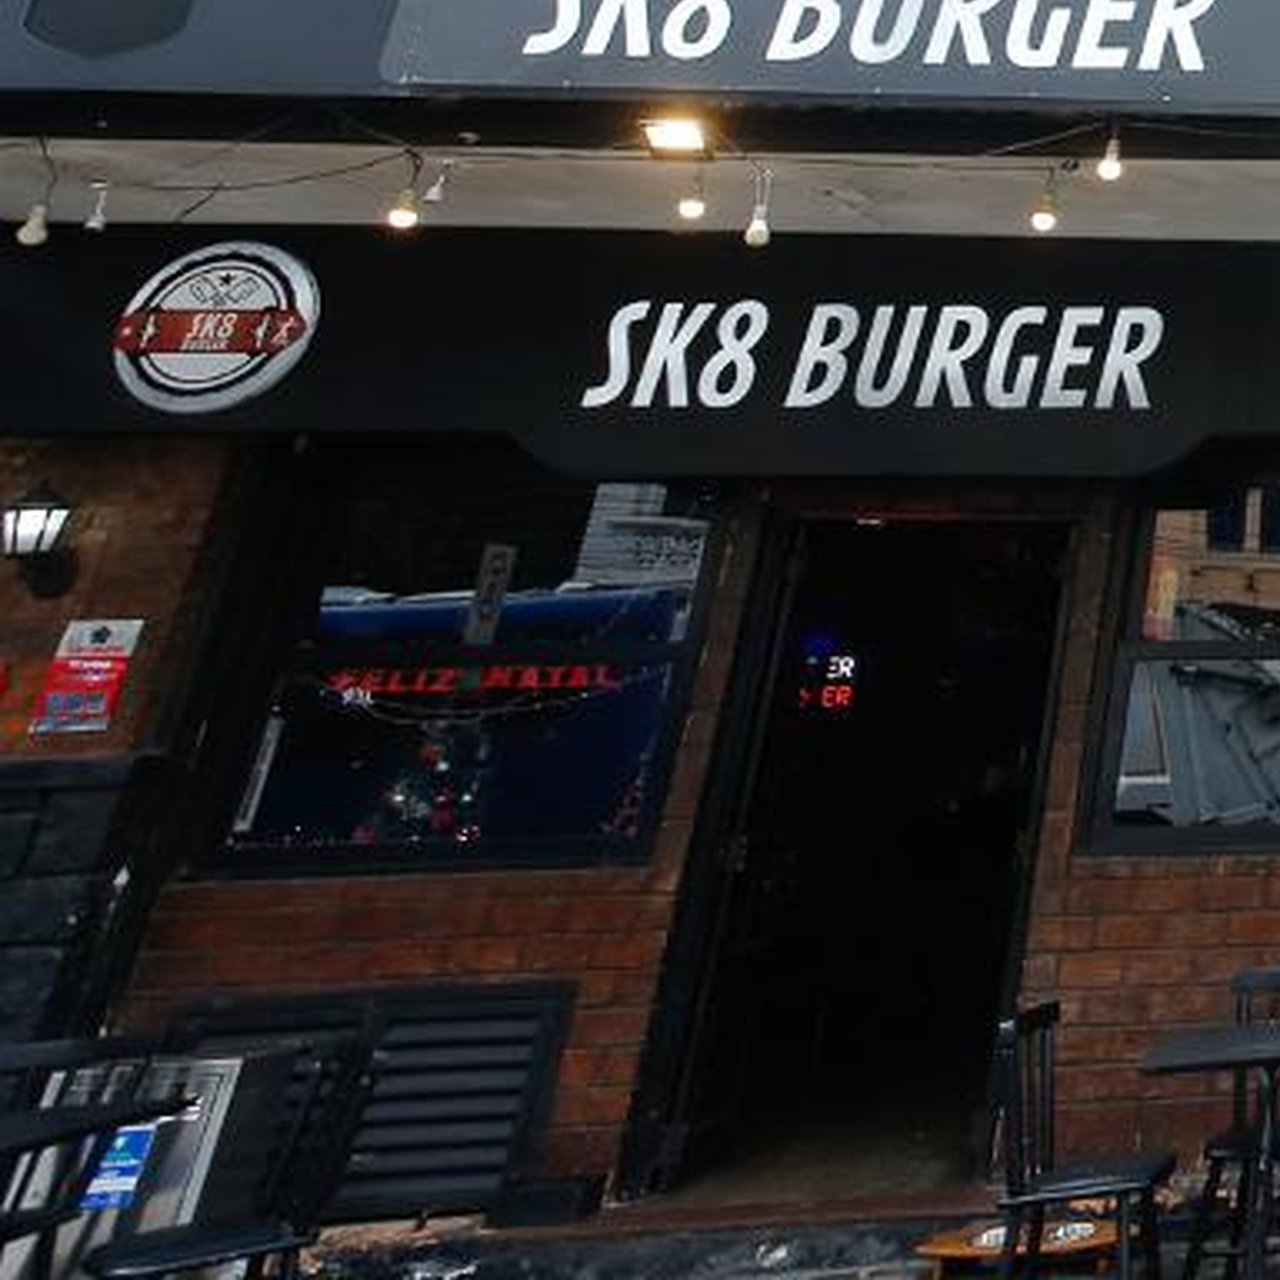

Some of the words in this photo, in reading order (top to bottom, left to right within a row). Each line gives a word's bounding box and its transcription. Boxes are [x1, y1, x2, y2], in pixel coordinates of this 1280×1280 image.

[186, 313, 238, 338] SK8
[580, 300, 769, 408] SK8
[783, 303, 1165, 409] BURGER
